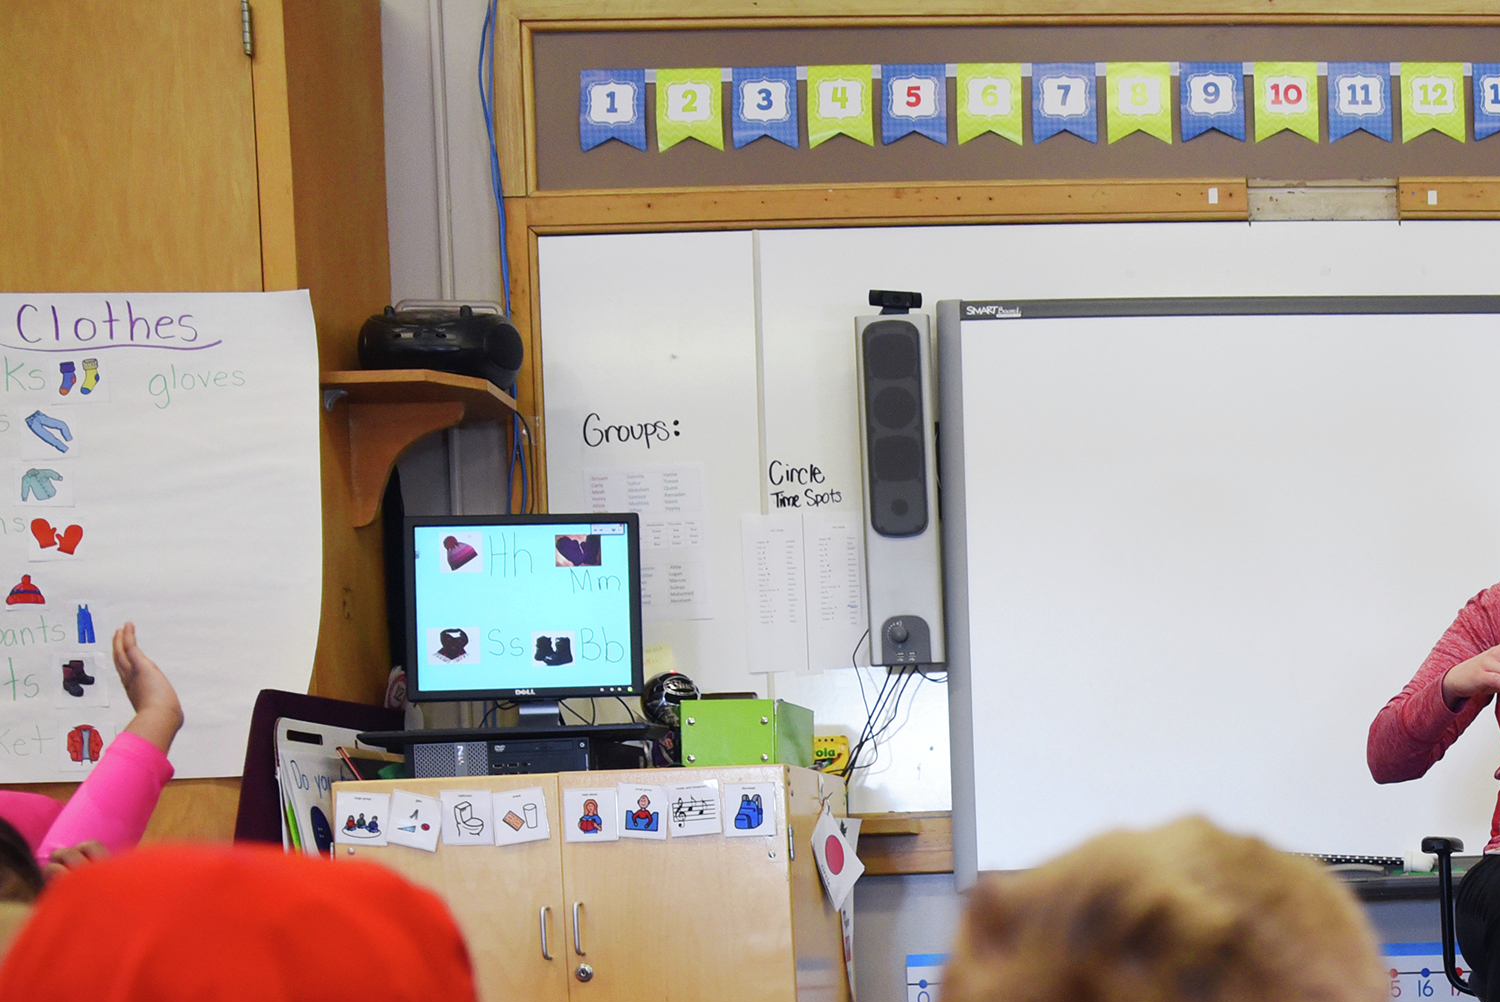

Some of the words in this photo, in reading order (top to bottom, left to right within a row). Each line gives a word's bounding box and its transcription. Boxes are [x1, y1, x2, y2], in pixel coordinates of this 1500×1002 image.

[605, 91, 618, 114] 1
[682, 90, 697, 112] 2
[757, 89, 773, 111] 3
[831, 87, 848, 109] 4
[906, 85, 921, 107] 5
[981, 85, 998, 107] 6
[1057, 85, 1071, 107] 7
[1130, 84, 1147, 106] 8
[1203, 82, 1220, 104] 9
[1270, 83, 1303, 106] 10
[1347, 82, 1373, 106] 11
[1419, 83, 1447, 106] 12
[966, 305, 998, 315] SMART
[147, 363, 246, 409] gloves
[583, 413, 680, 449] Groups:
[769, 460, 825, 485] Circle
[770, 492, 802, 509] Time
[804, 488, 842, 507] Spots
[1417, 980, 1434, 998] 16
